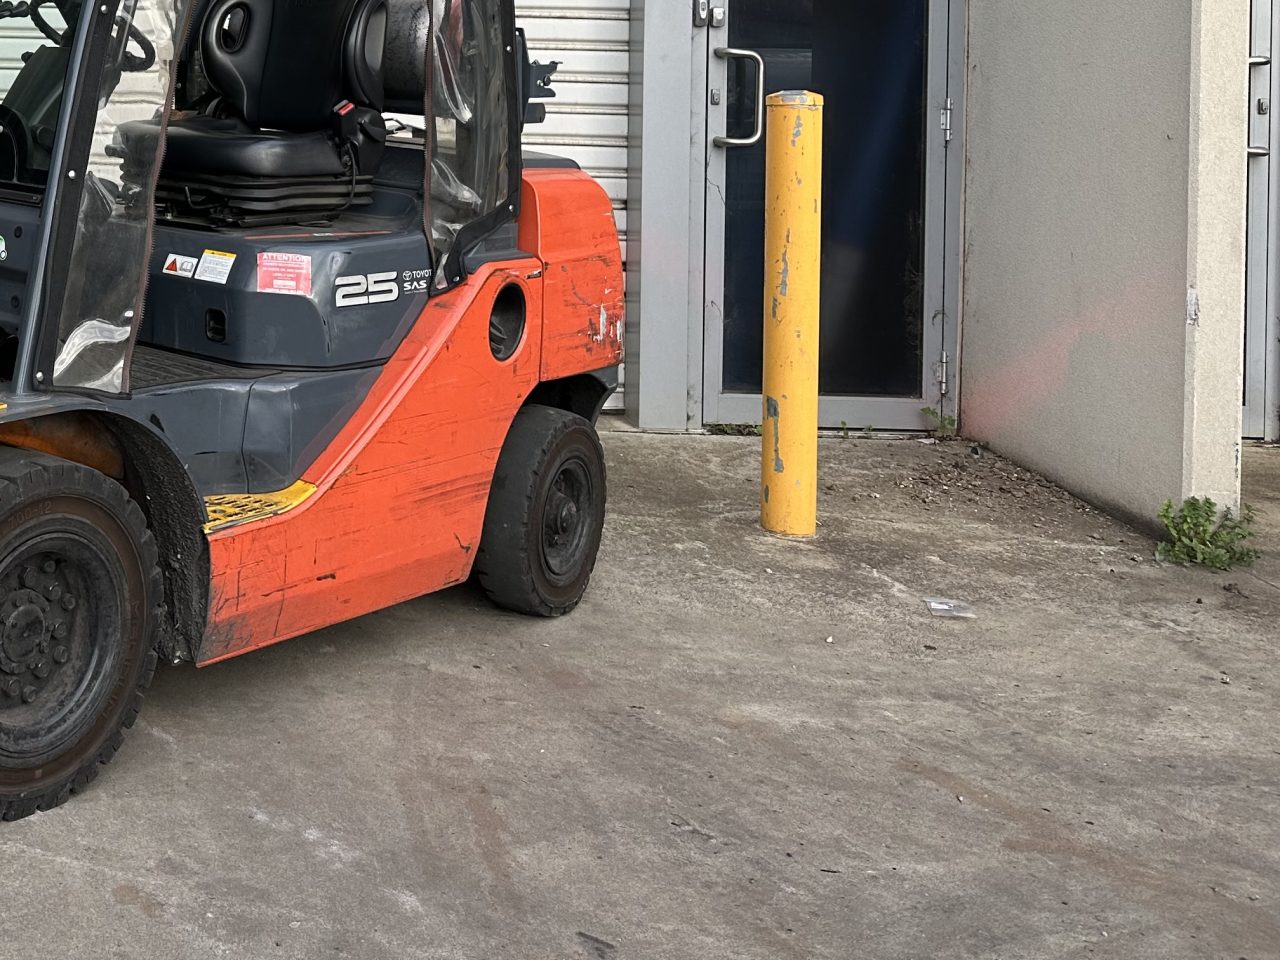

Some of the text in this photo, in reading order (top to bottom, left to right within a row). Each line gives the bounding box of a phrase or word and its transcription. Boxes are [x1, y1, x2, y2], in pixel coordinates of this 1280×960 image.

[412, 269, 432, 279] TOYOT
[335, 271, 399, 308] 25
[403, 280, 427, 291] SAS
